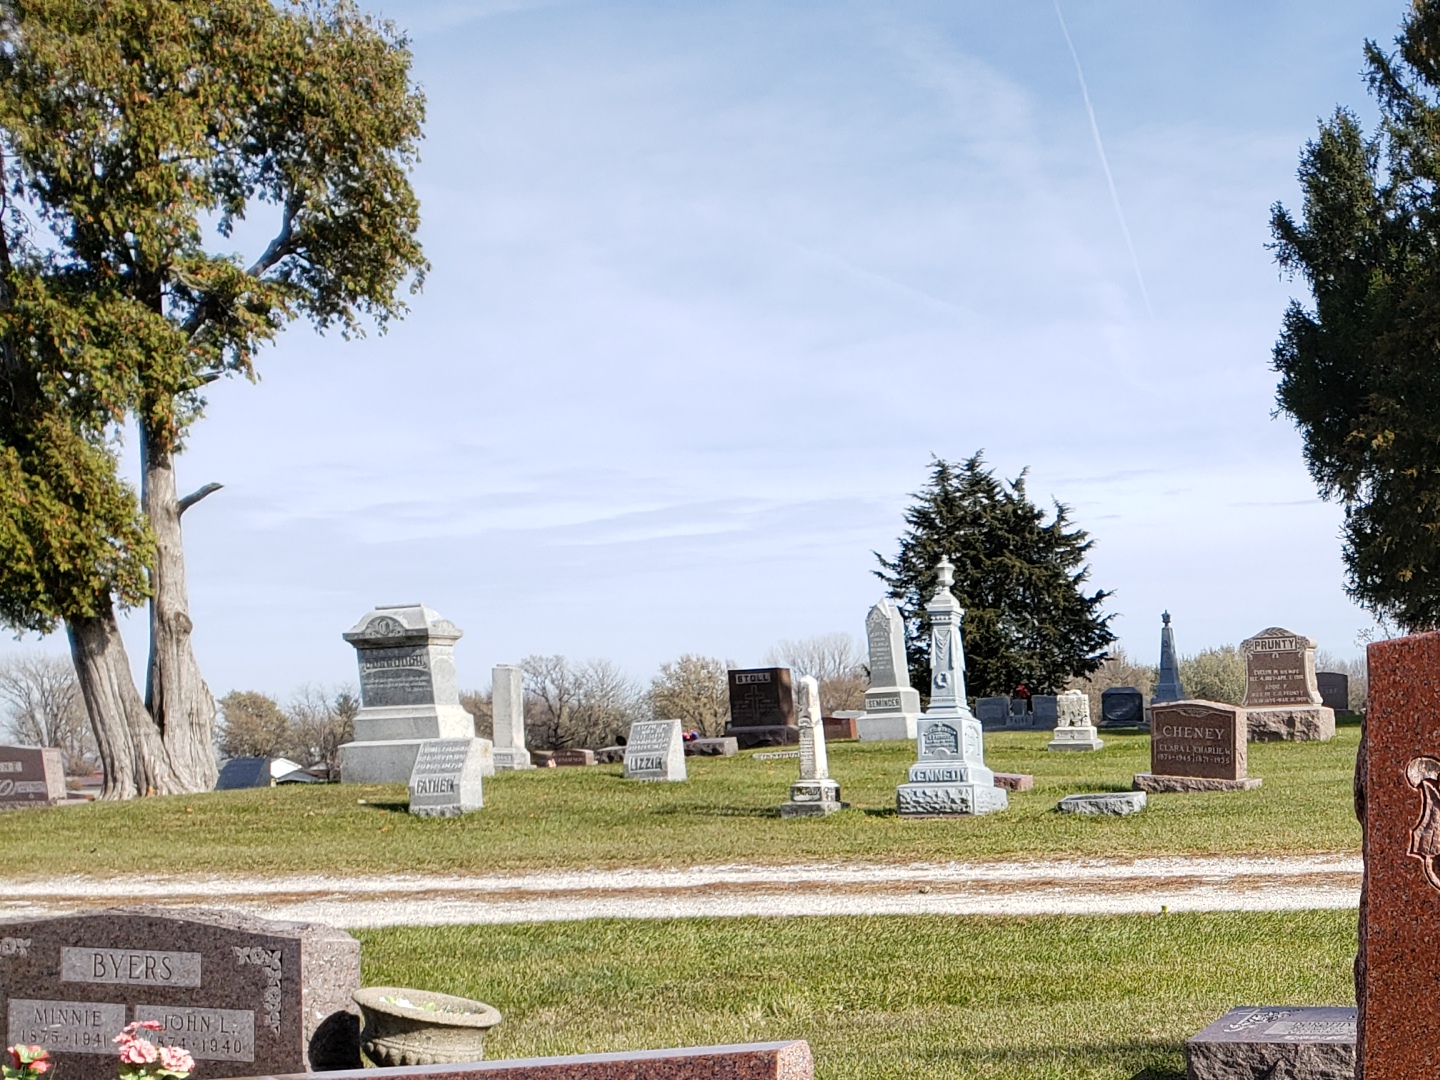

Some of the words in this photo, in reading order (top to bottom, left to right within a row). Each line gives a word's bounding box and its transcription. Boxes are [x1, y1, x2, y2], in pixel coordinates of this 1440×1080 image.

[1254, 639, 1295, 650] PRUNTY
[737, 673, 769, 683] STOLL
[1162, 725, 1225, 739] CHENEY
[1159, 744, 1185, 753] CLARA
[1193, 745, 1224, 755] CHARLIE
[629, 756, 663, 772] LIZZIE
[909, 768, 968, 782] KENNEDY
[415, 778, 455, 794] FATHER
[92, 952, 172, 982] BYERS
[34, 1007, 102, 1026] MINNIE
[163, 1014, 210, 1032] JOHN
[220, 1016, 236, 1034] L.
